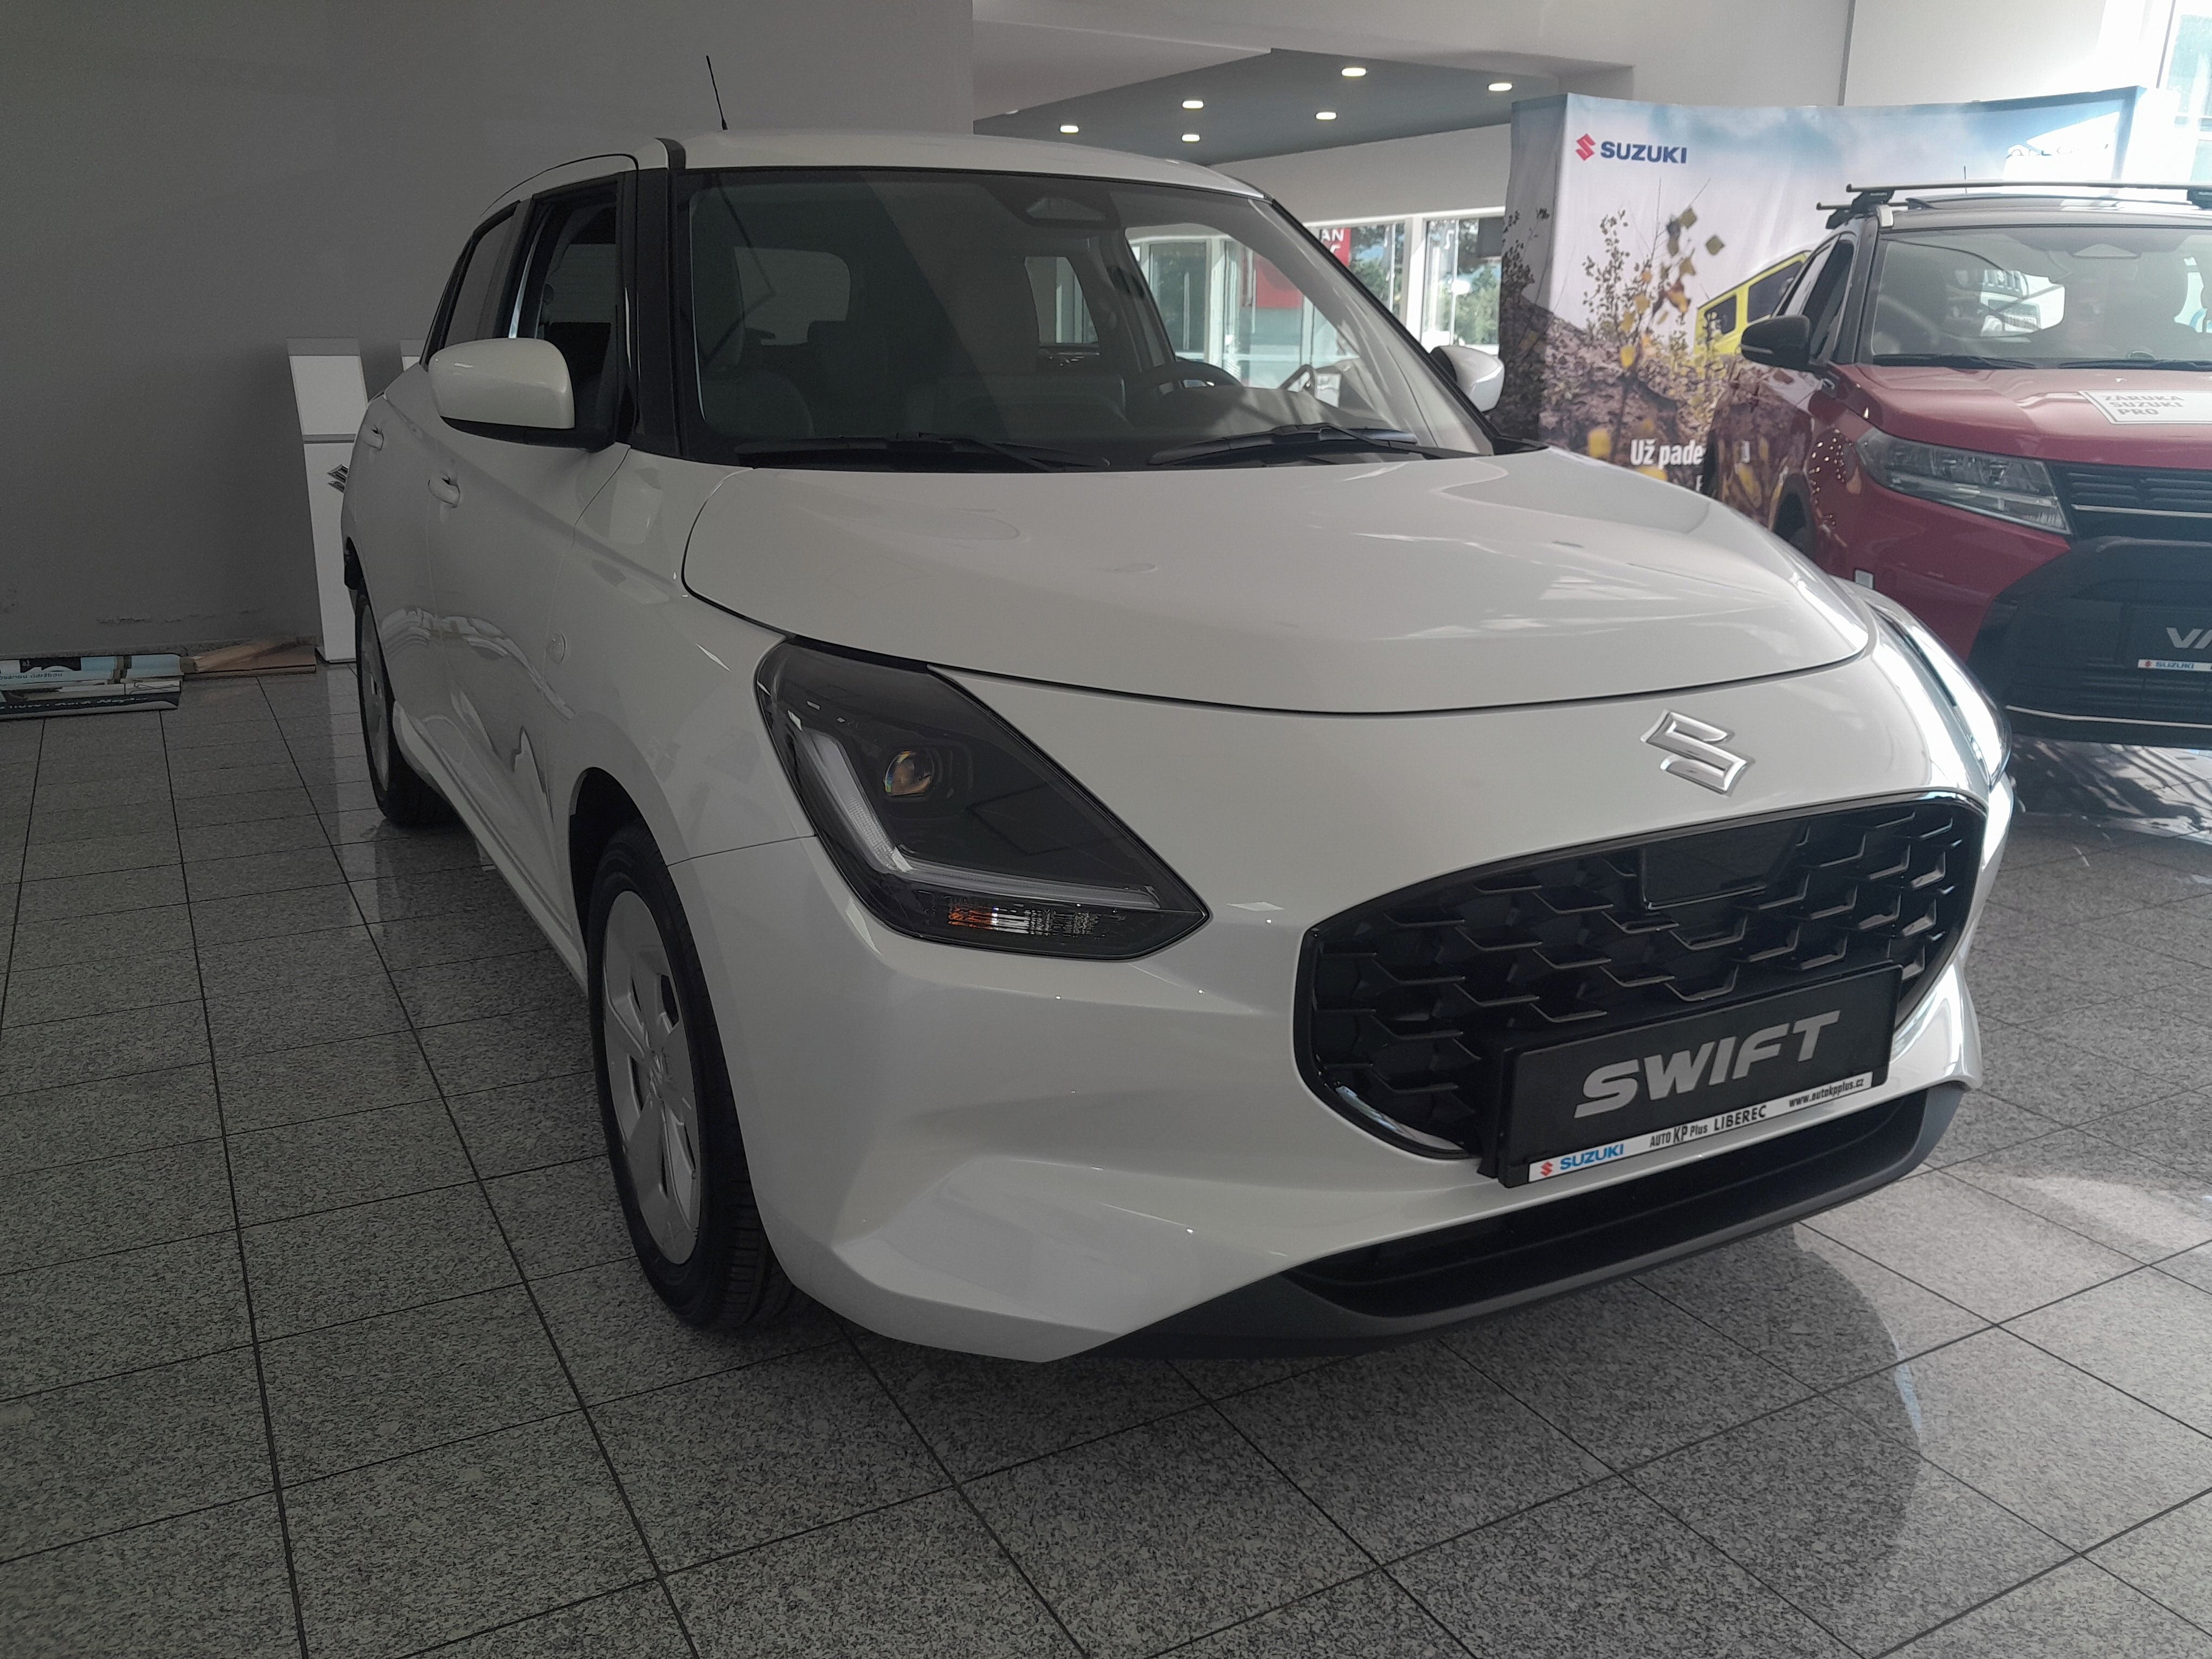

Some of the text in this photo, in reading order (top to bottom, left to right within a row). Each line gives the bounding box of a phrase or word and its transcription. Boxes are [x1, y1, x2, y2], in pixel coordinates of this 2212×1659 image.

[1600, 141, 1687, 164] SUZUKI
[1630, 438, 1657, 465] Už
[1658, 439, 1707, 470] pade
[2155, 660, 2195, 669] SUZUKI
[1573, 1009, 1840, 1118] SWIFT
[1560, 1079, 1864, 1170] SUZUKI AUTO KP Plus LIBEREC www.autokpplus.cz
